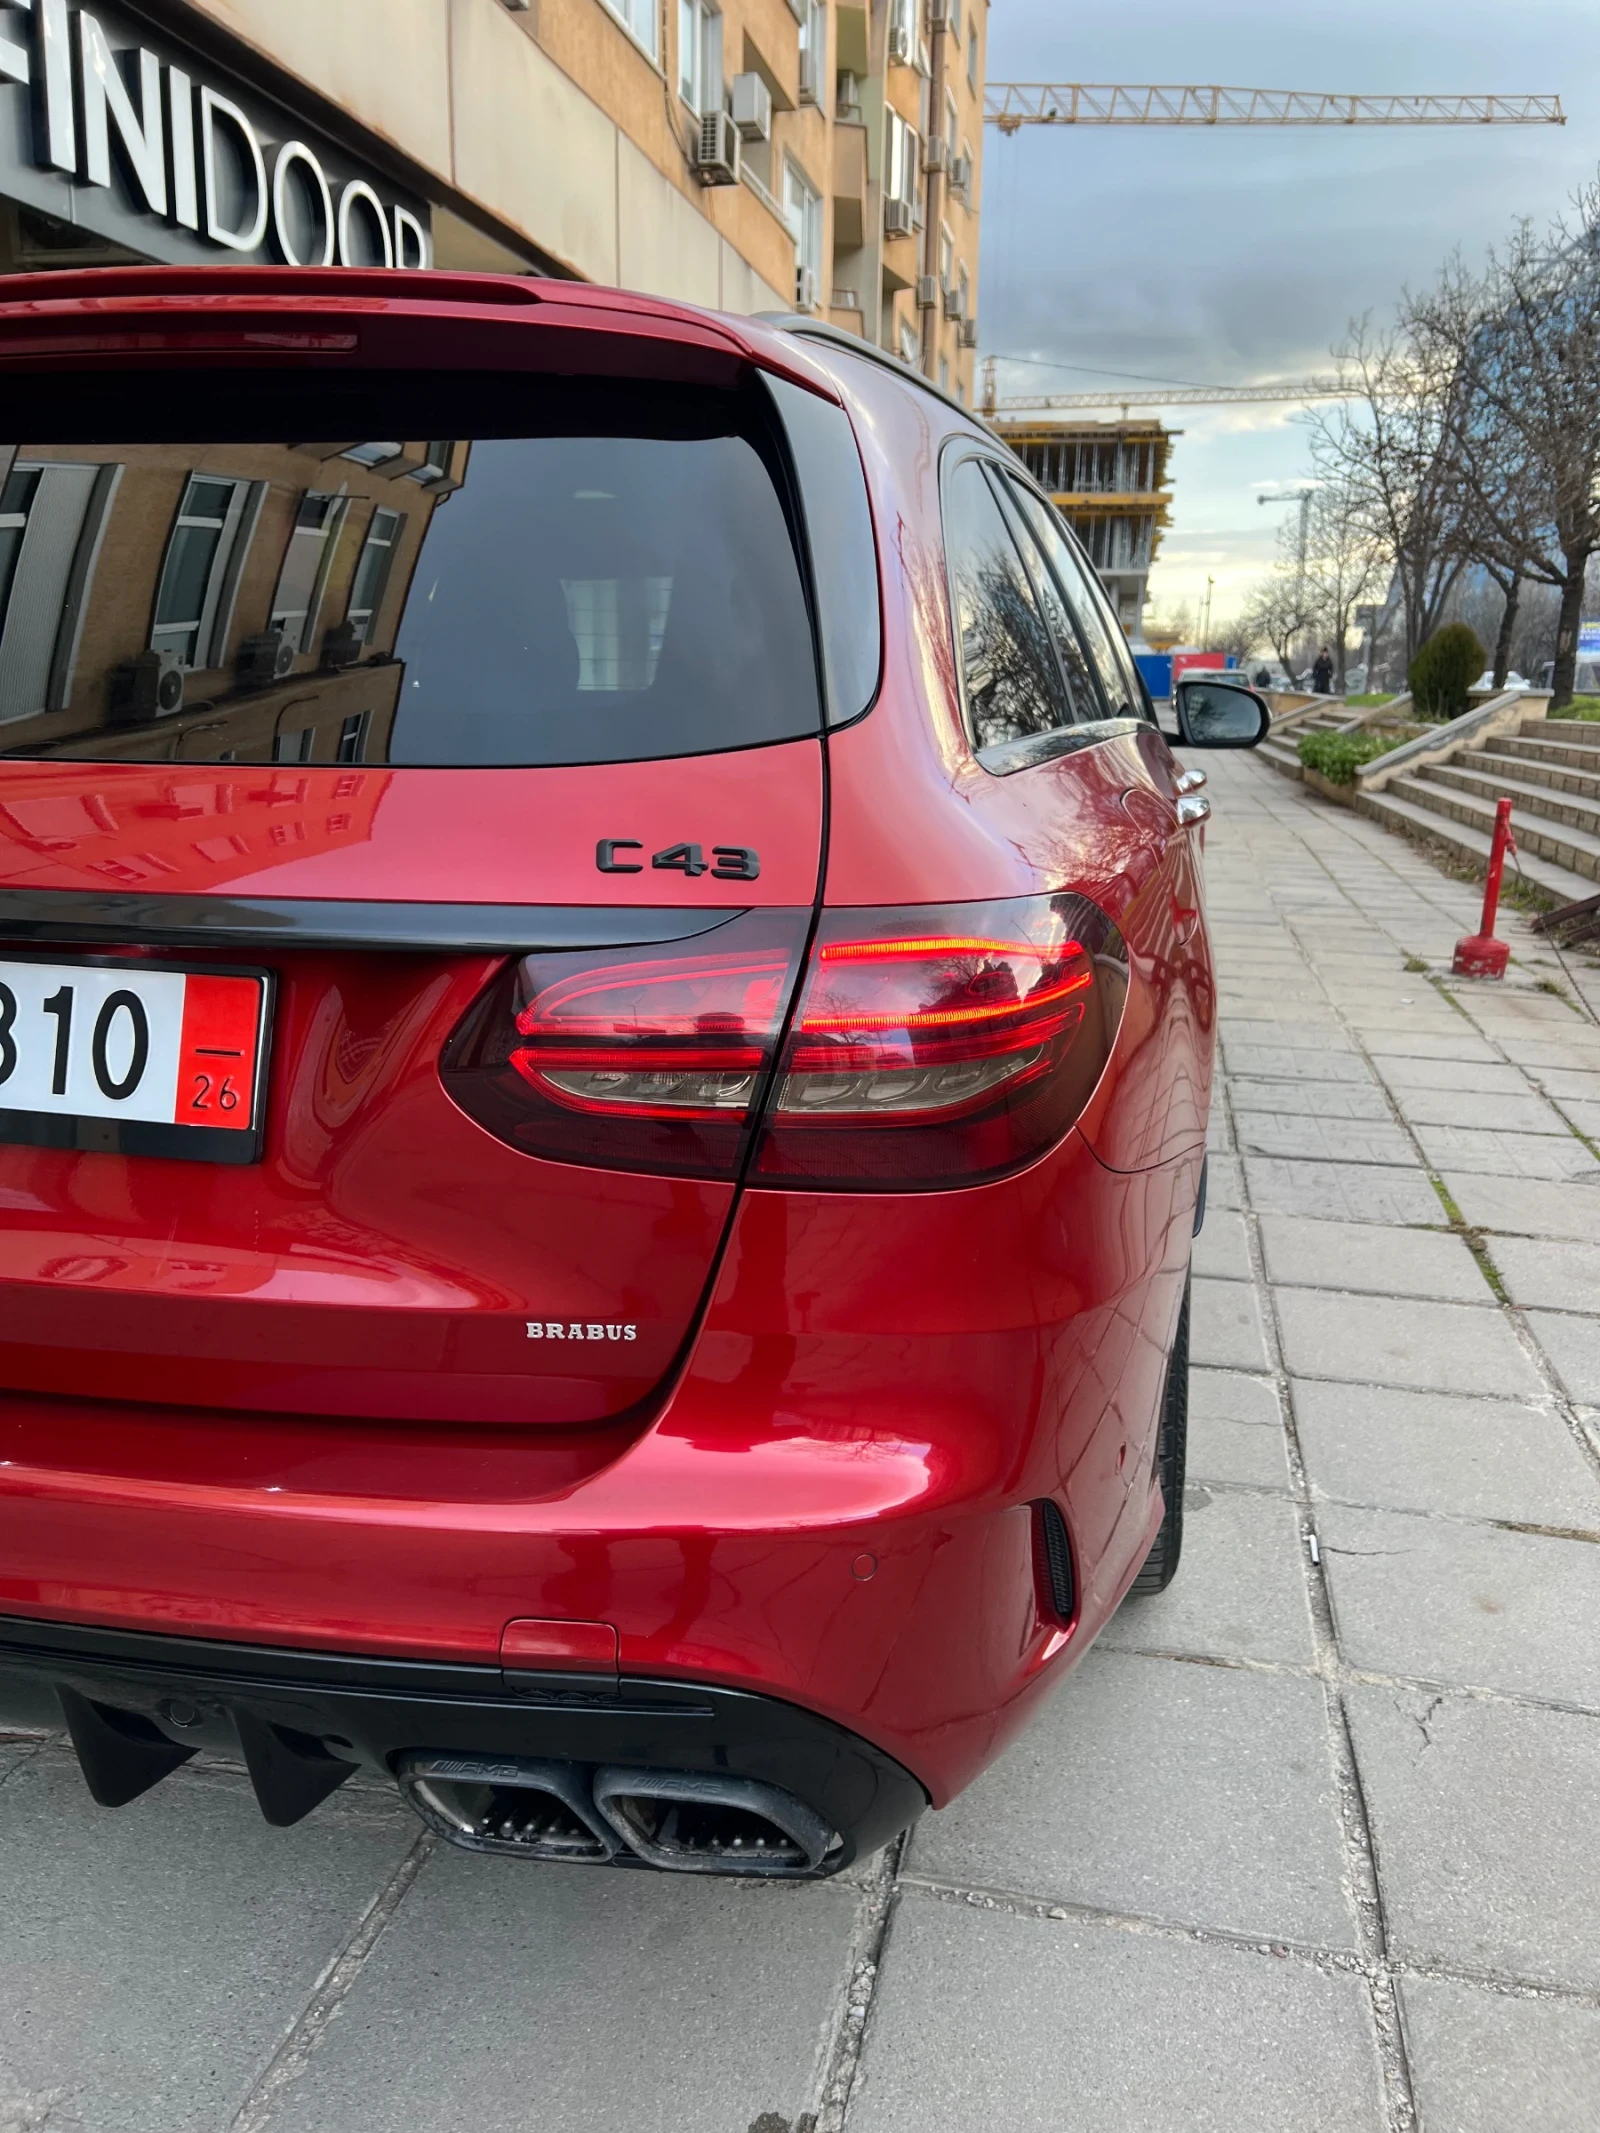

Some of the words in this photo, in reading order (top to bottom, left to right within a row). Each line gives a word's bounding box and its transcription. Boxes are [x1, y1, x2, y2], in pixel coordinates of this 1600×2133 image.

[596, 838, 643, 873] C
[651, 842, 760, 881] 43
[192, 1075, 238, 1111] 26
[526, 1322, 637, 1341] BRABUS
